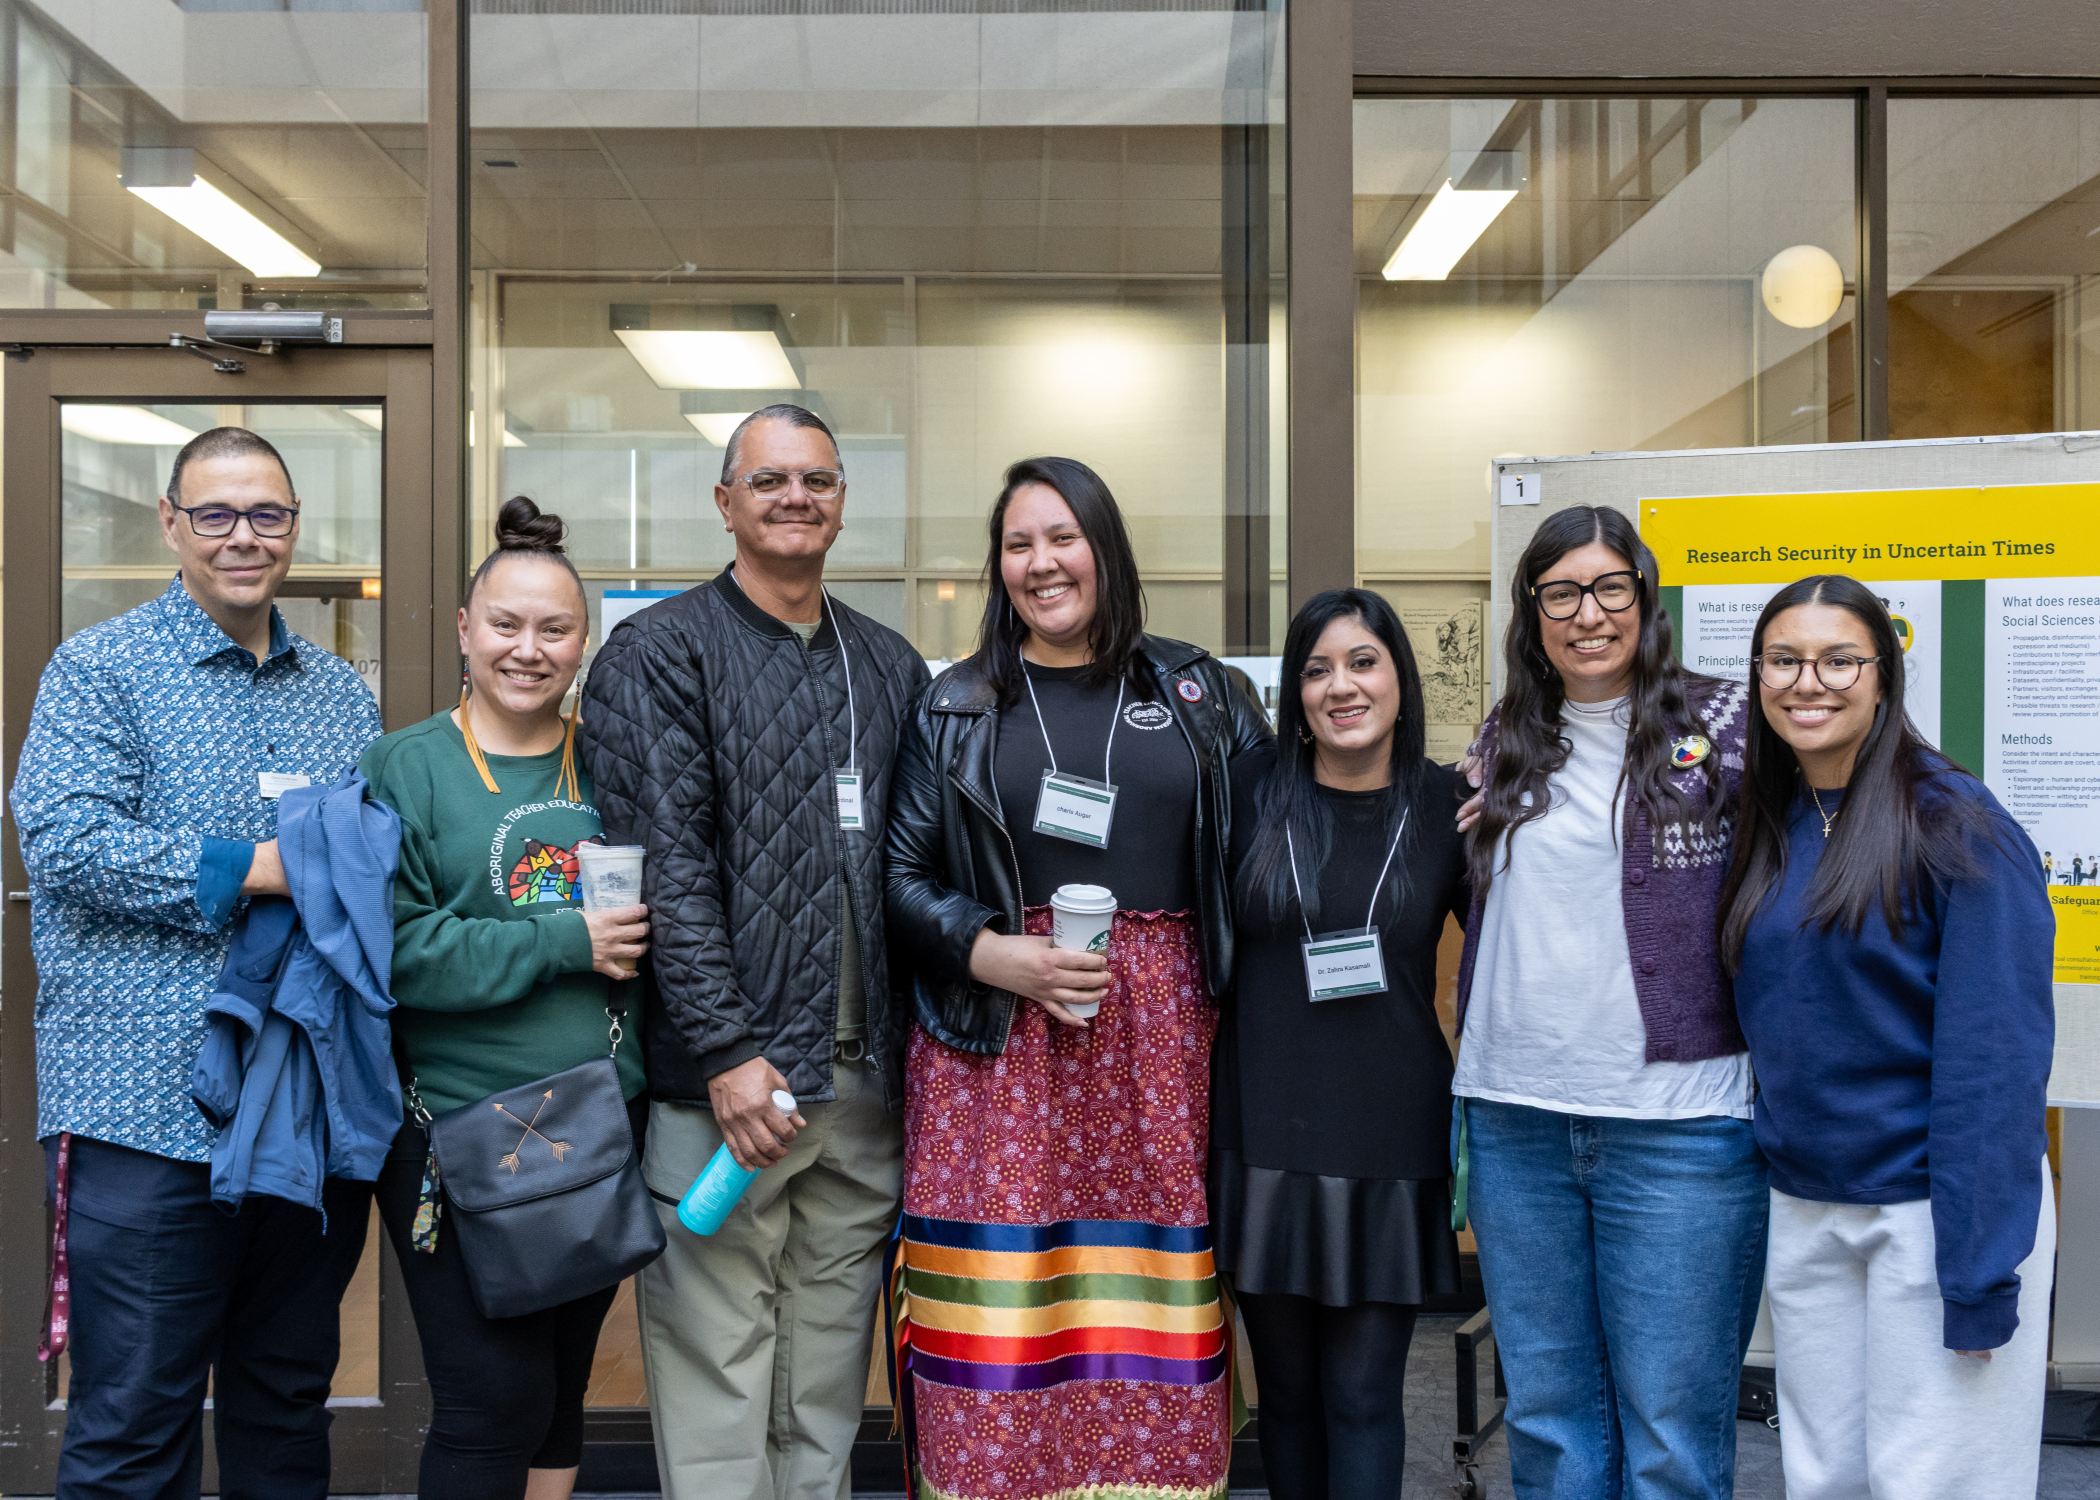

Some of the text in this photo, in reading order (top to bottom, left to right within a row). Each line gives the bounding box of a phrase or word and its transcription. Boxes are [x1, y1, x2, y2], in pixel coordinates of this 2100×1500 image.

[1516, 482, 1523, 498] 1
[1686, 540, 2056, 564] Research Security in Uncertain Times
[1698, 602, 1764, 612] What is rese
[2002, 596, 2100, 607] What does resea
[2002, 614, 2094, 626] Social Sciences
[1698, 656, 1751, 668] Principles
[2002, 733, 2052, 744] Methods
[490, 823, 512, 895] ABORIGINAL
[504, 802, 548, 822] TEACHER
[2052, 896, 2100, 907] Safeguar
